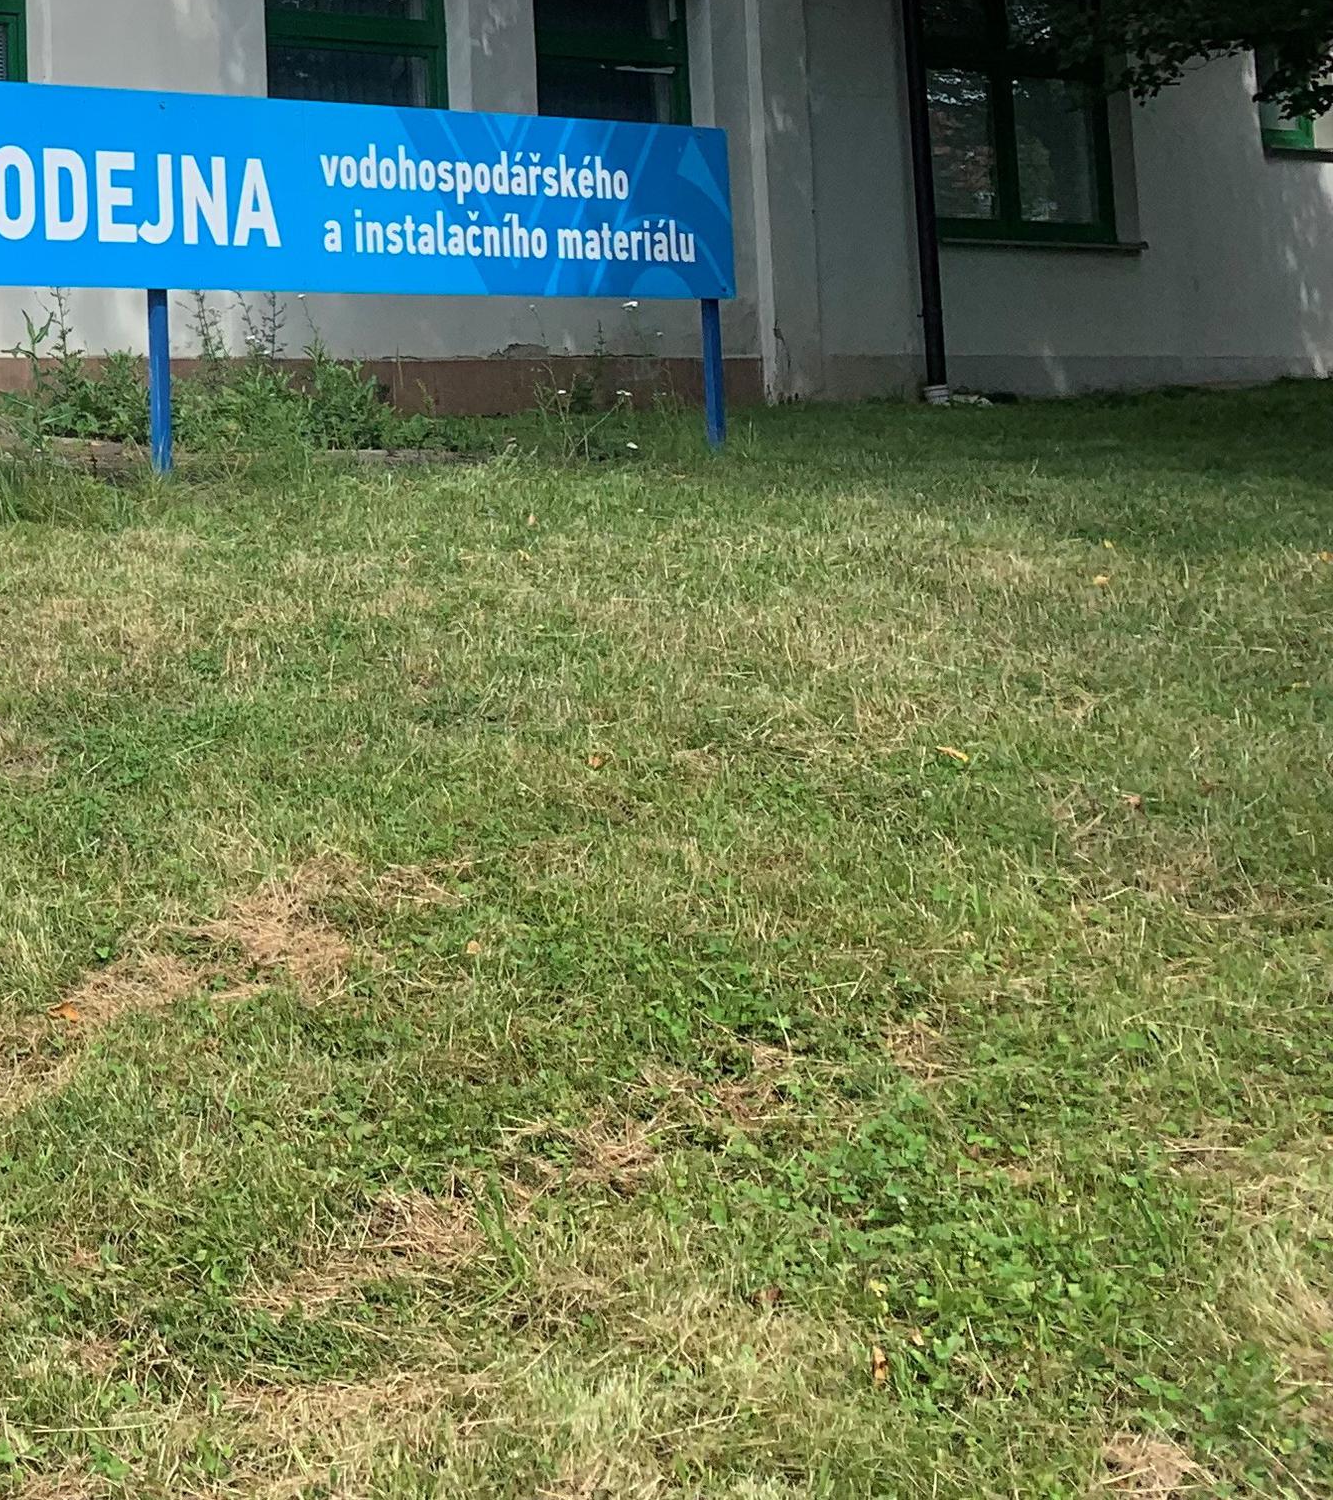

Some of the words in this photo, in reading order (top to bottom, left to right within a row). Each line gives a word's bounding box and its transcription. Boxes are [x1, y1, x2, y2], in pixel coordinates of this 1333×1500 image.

[319, 143, 629, 204] vodohospodářského
[323, 219, 343, 253] a
[354, 209, 548, 259] instalačního
[557, 218, 696, 263] materiálu
